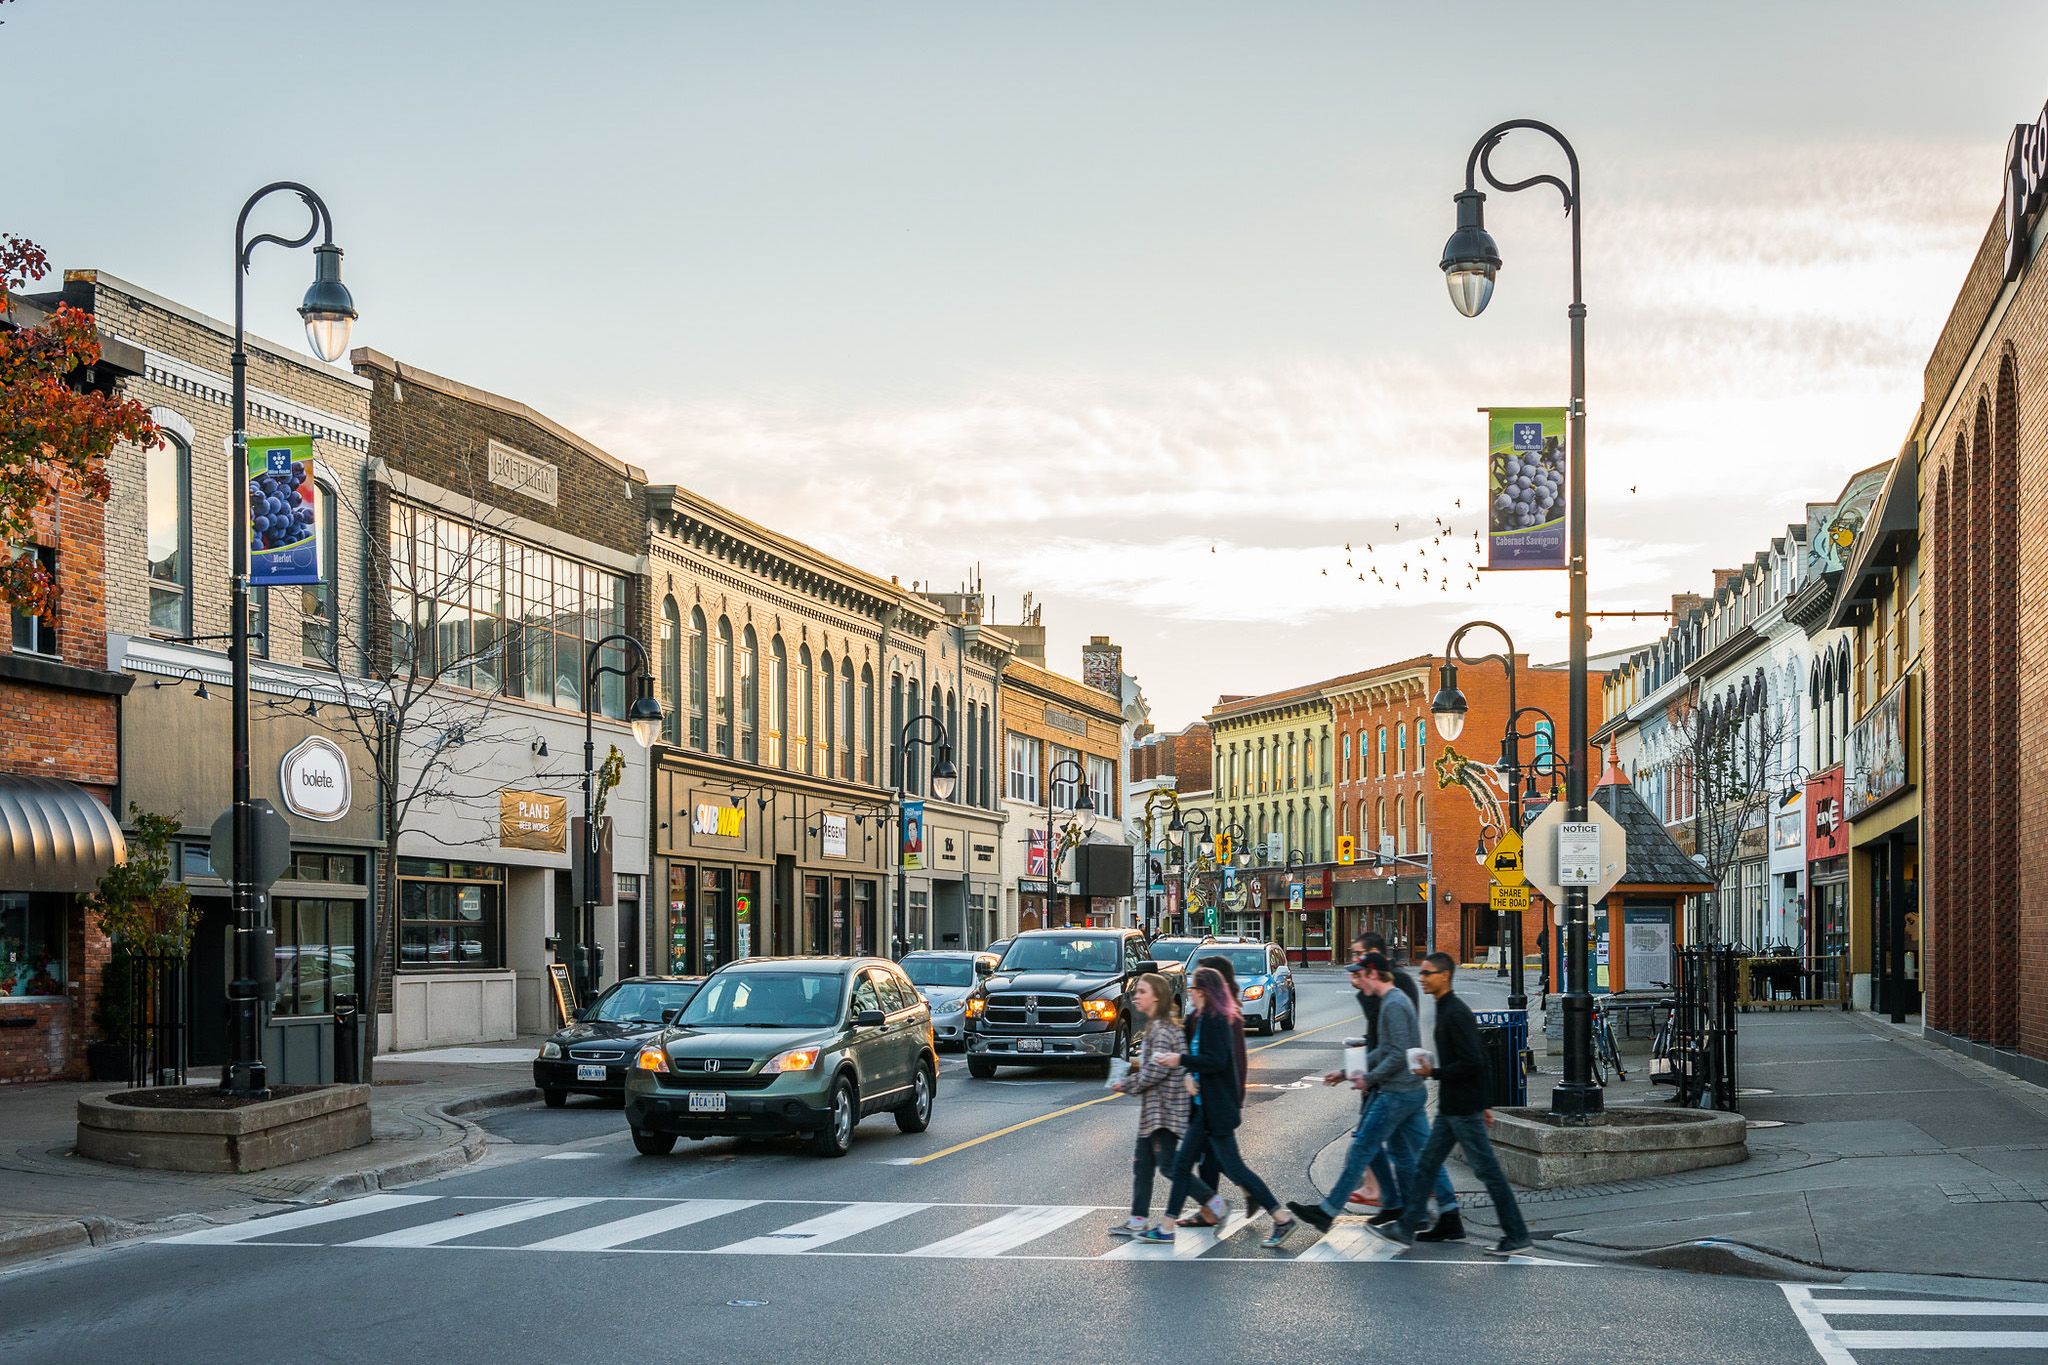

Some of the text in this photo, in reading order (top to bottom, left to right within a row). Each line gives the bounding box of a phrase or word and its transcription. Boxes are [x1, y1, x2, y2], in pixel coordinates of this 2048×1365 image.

[494, 451, 549, 494] HOFFMAN
[1495, 536, 1559, 548] Cabernet Sauvignon
[273, 553, 292, 563] Merlot
[518, 801, 550, 820] PLAN B
[518, 821, 531, 830] BEER
[692, 803, 746, 838] SUBWAY
[1563, 825, 1597, 833] NOTICE
[1499, 888, 1521, 898] SHARE
[1493, 898, 1527, 908] THE ROAD
[1207, 908, 1215, 918] P
